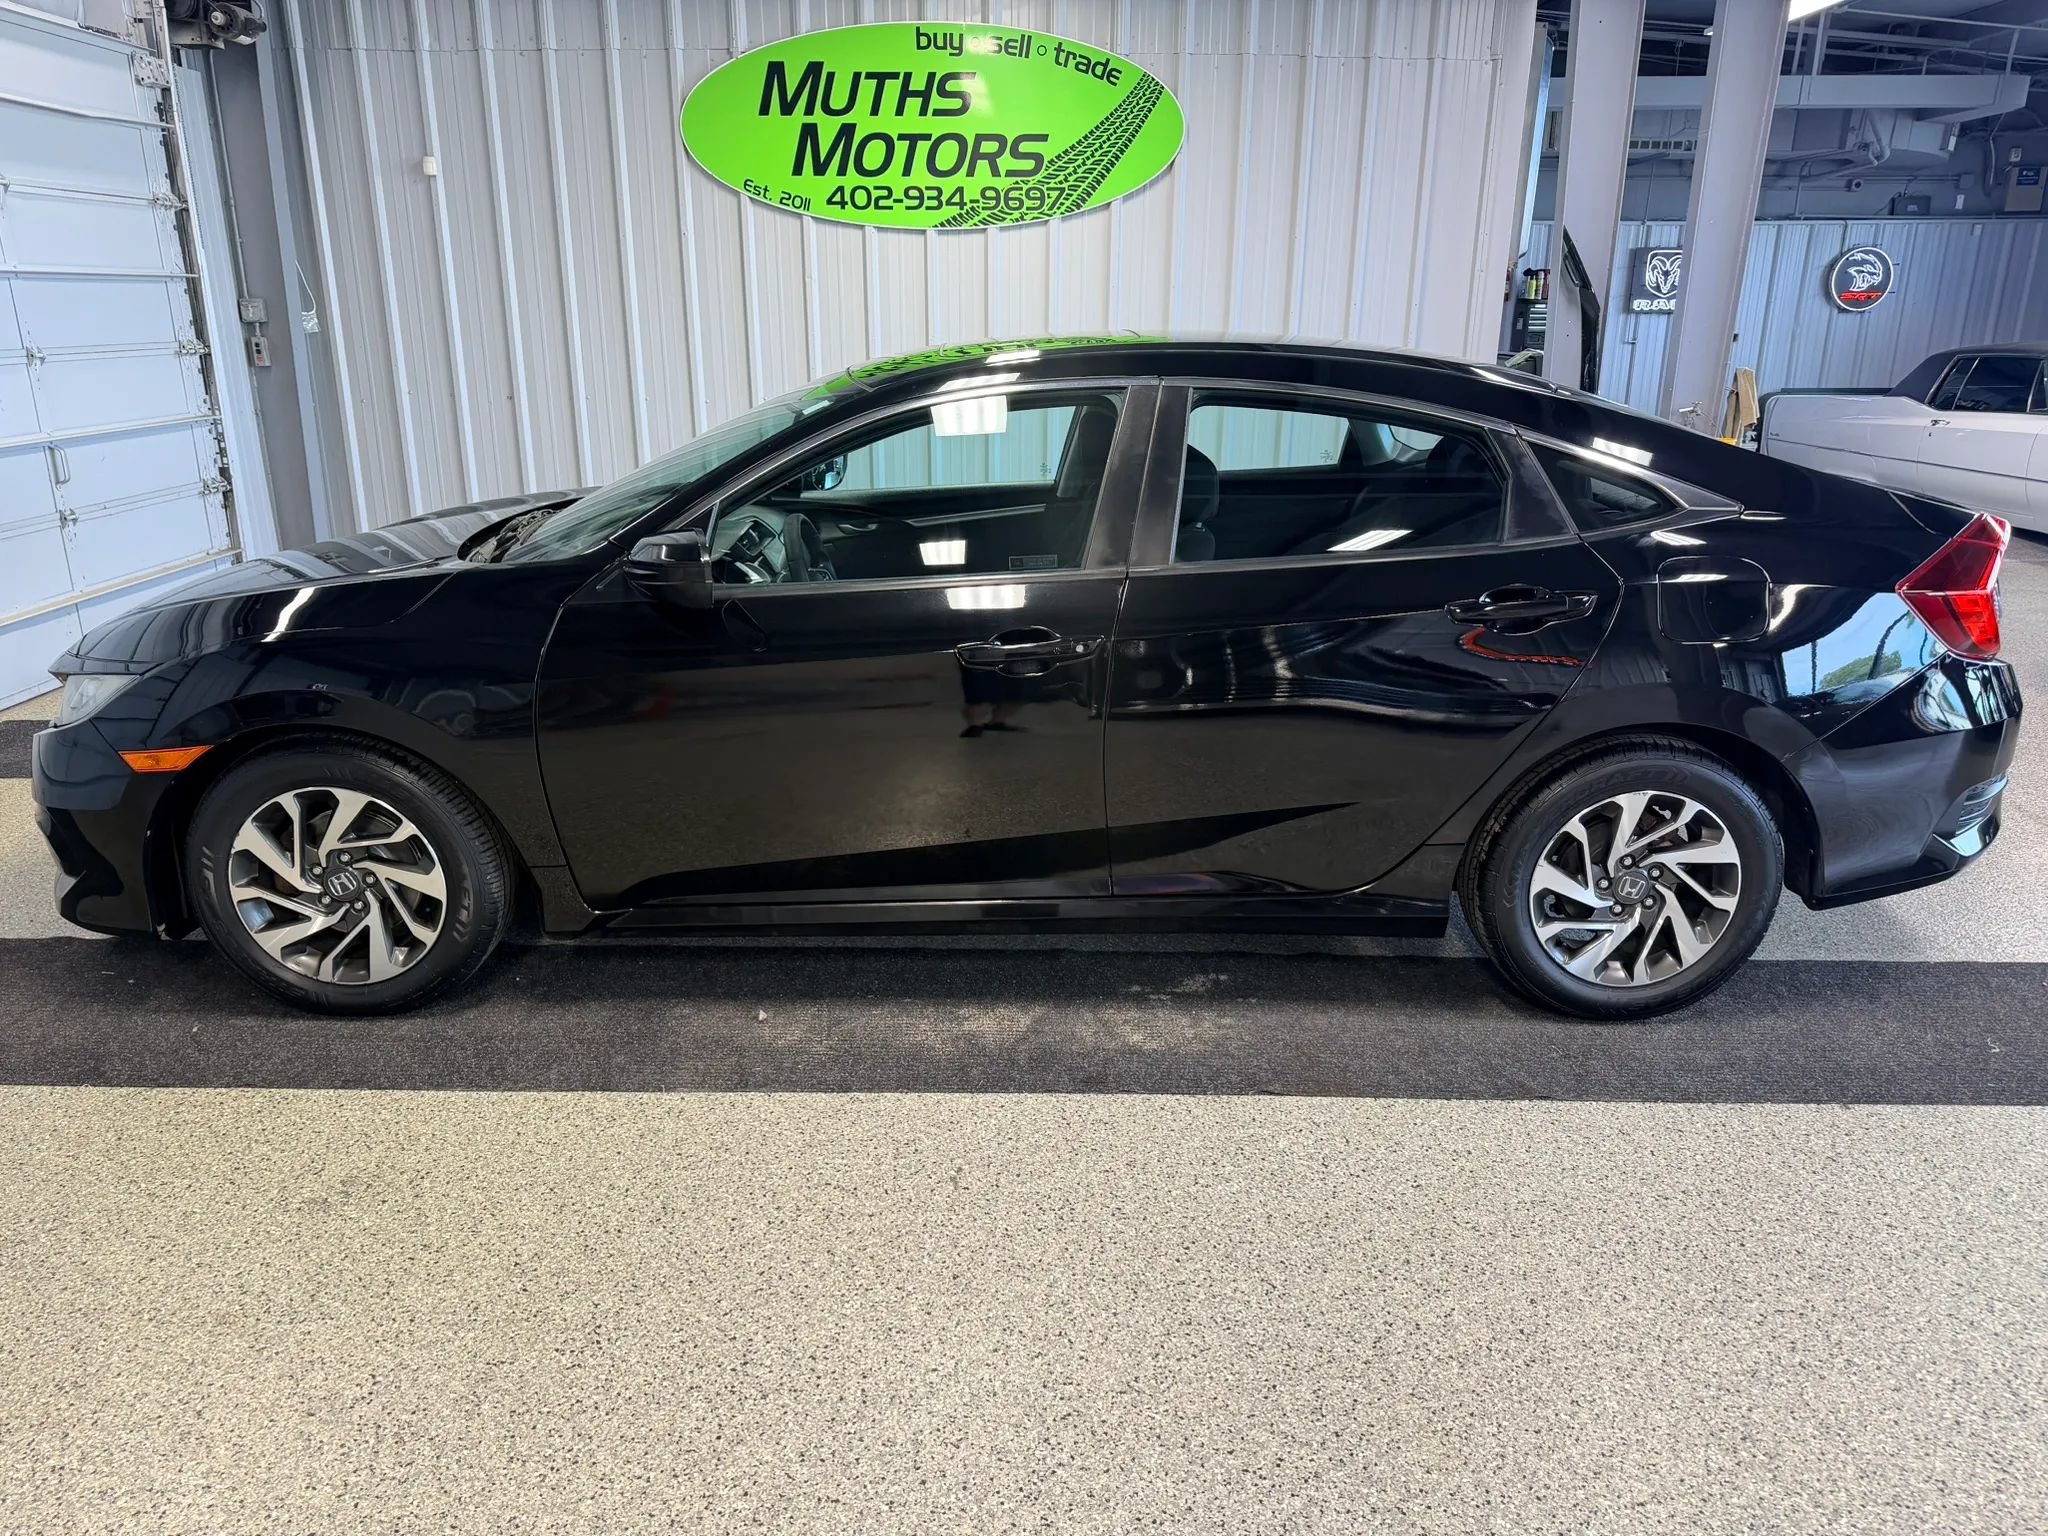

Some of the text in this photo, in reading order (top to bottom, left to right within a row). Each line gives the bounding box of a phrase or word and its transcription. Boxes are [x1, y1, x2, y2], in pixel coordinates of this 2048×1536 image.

[916, 26, 1123, 87] buy sell trade
[758, 60, 977, 117] MUTHS
[791, 122, 1050, 178] MOTORS
[743, 178, 811, 212] Est. 2011
[826, 185, 1067, 212] 402-934-9697
[1840, 291, 1882, 301] SRT
